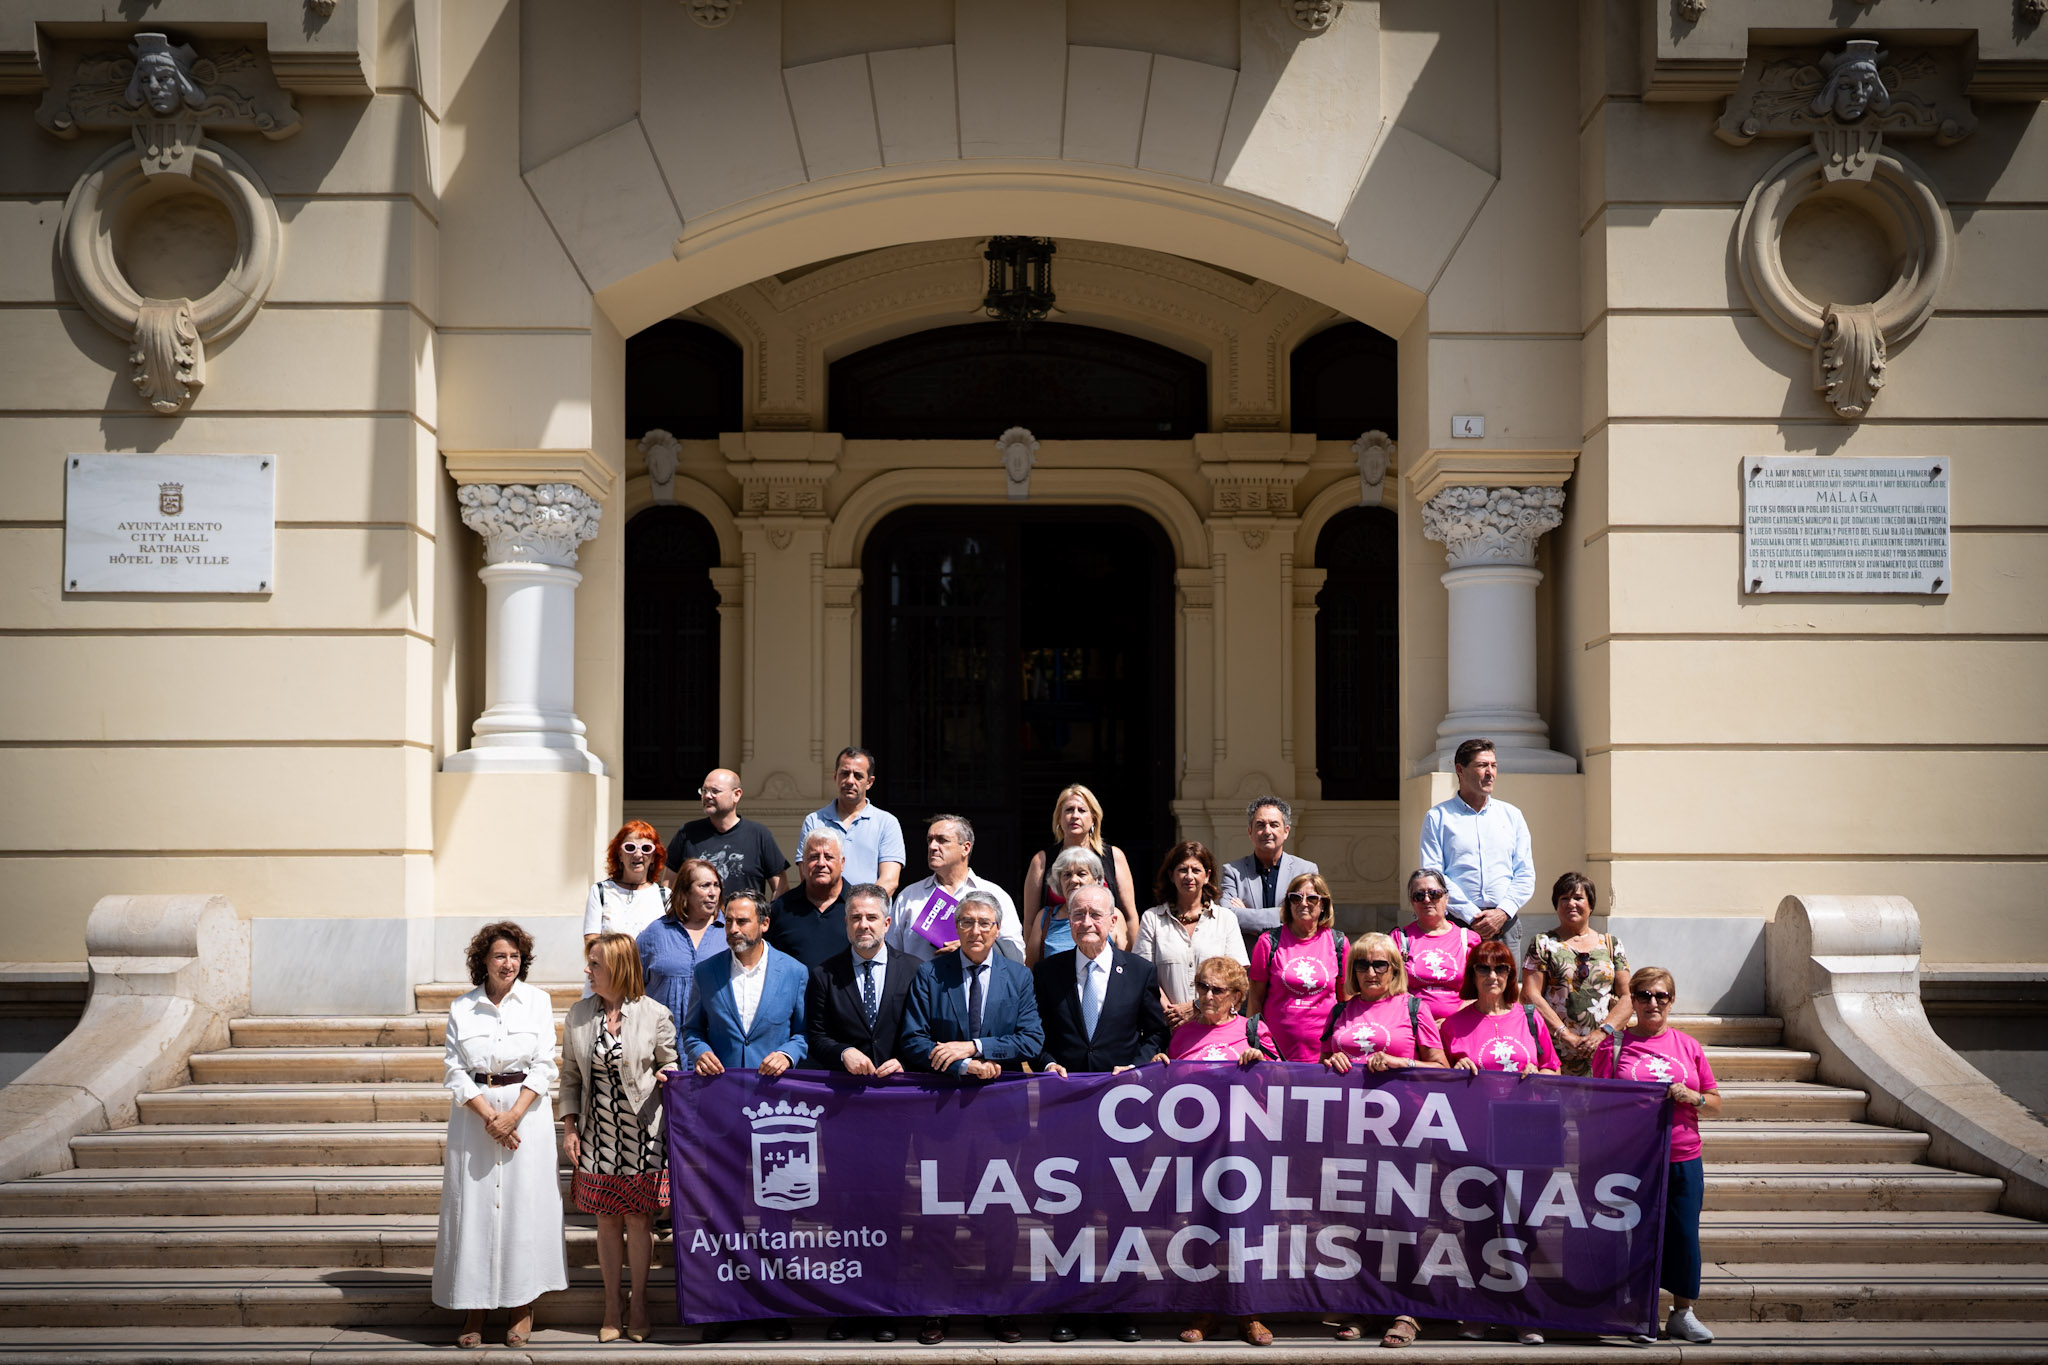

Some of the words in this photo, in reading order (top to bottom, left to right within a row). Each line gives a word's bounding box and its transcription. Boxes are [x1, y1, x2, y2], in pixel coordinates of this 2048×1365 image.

[1465, 420, 1472, 433] 4
[1844, 469, 1867, 478] SIEMPRE
[1777, 505, 1796, 513] ORIGEN
[1806, 505, 1829, 513] POBLADO
[117, 522, 222, 531] AYUNTAMIENTO
[1754, 527, 1772, 535] LUEGO
[1773, 527, 1799, 535] VISIGODA
[1838, 527, 1860, 535] PUERTO
[1872, 527, 1890, 535] ISLAM
[131, 533, 166, 542] CITY
[174, 533, 208, 542] HALL
[139, 544, 200, 553] RATHAUS
[109, 553, 153, 564] HÔTEL
[161, 556, 178, 564] DE
[186, 556, 229, 565] VILLE
[1818, 560, 1856, 568] INSTITUYERON
[1785, 571, 1808, 579] PRIMER
[1810, 571, 1836, 579] CABILDO
[1098, 1083, 1468, 1152] CONTRA
[921, 1156, 1082, 1215] LAS
[1109, 1155, 1642, 1232] VIOLENCIAS
[690, 1226, 888, 1256] Ayuntamiento
[1030, 1224, 1528, 1293] MACHISTAS
[717, 1259, 750, 1282] de
[761, 1256, 863, 1284] Málaga
